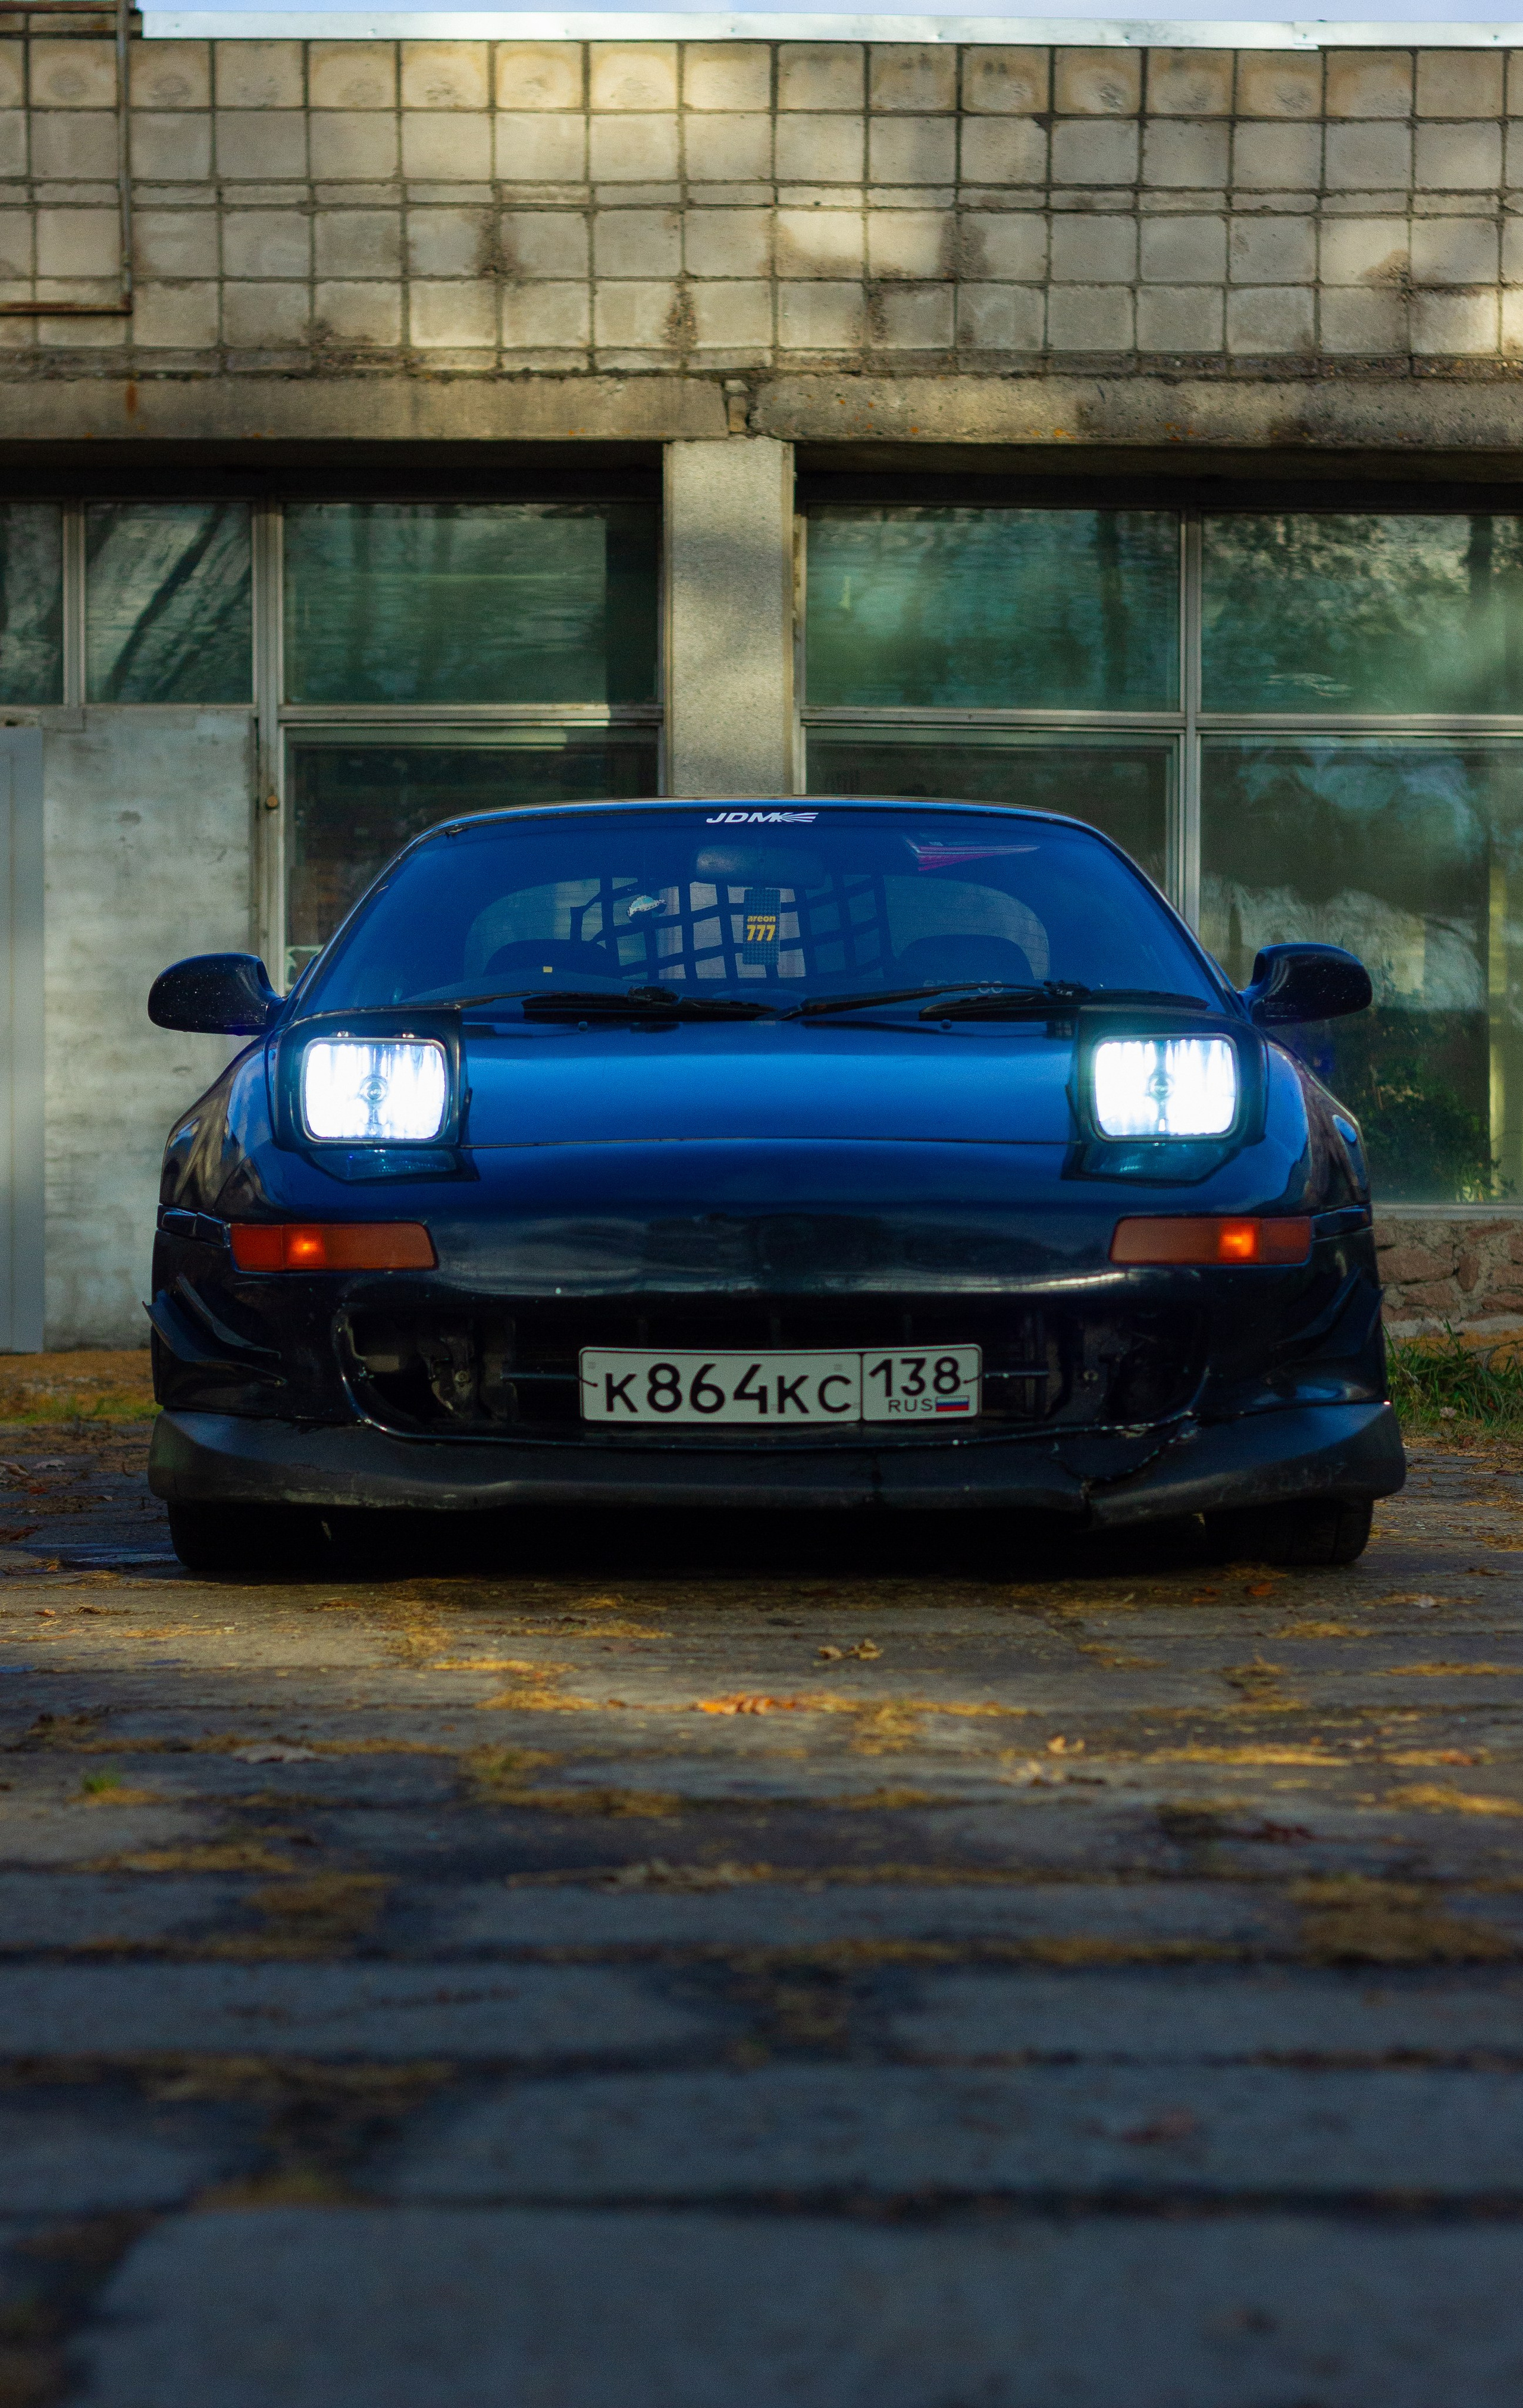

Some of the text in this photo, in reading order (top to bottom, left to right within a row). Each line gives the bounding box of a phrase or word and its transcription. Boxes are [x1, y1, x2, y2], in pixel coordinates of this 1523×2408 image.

[747, 925, 776, 941] 777
[869, 1357, 961, 1397] 138
[888, 1398, 933, 1413] RUS
